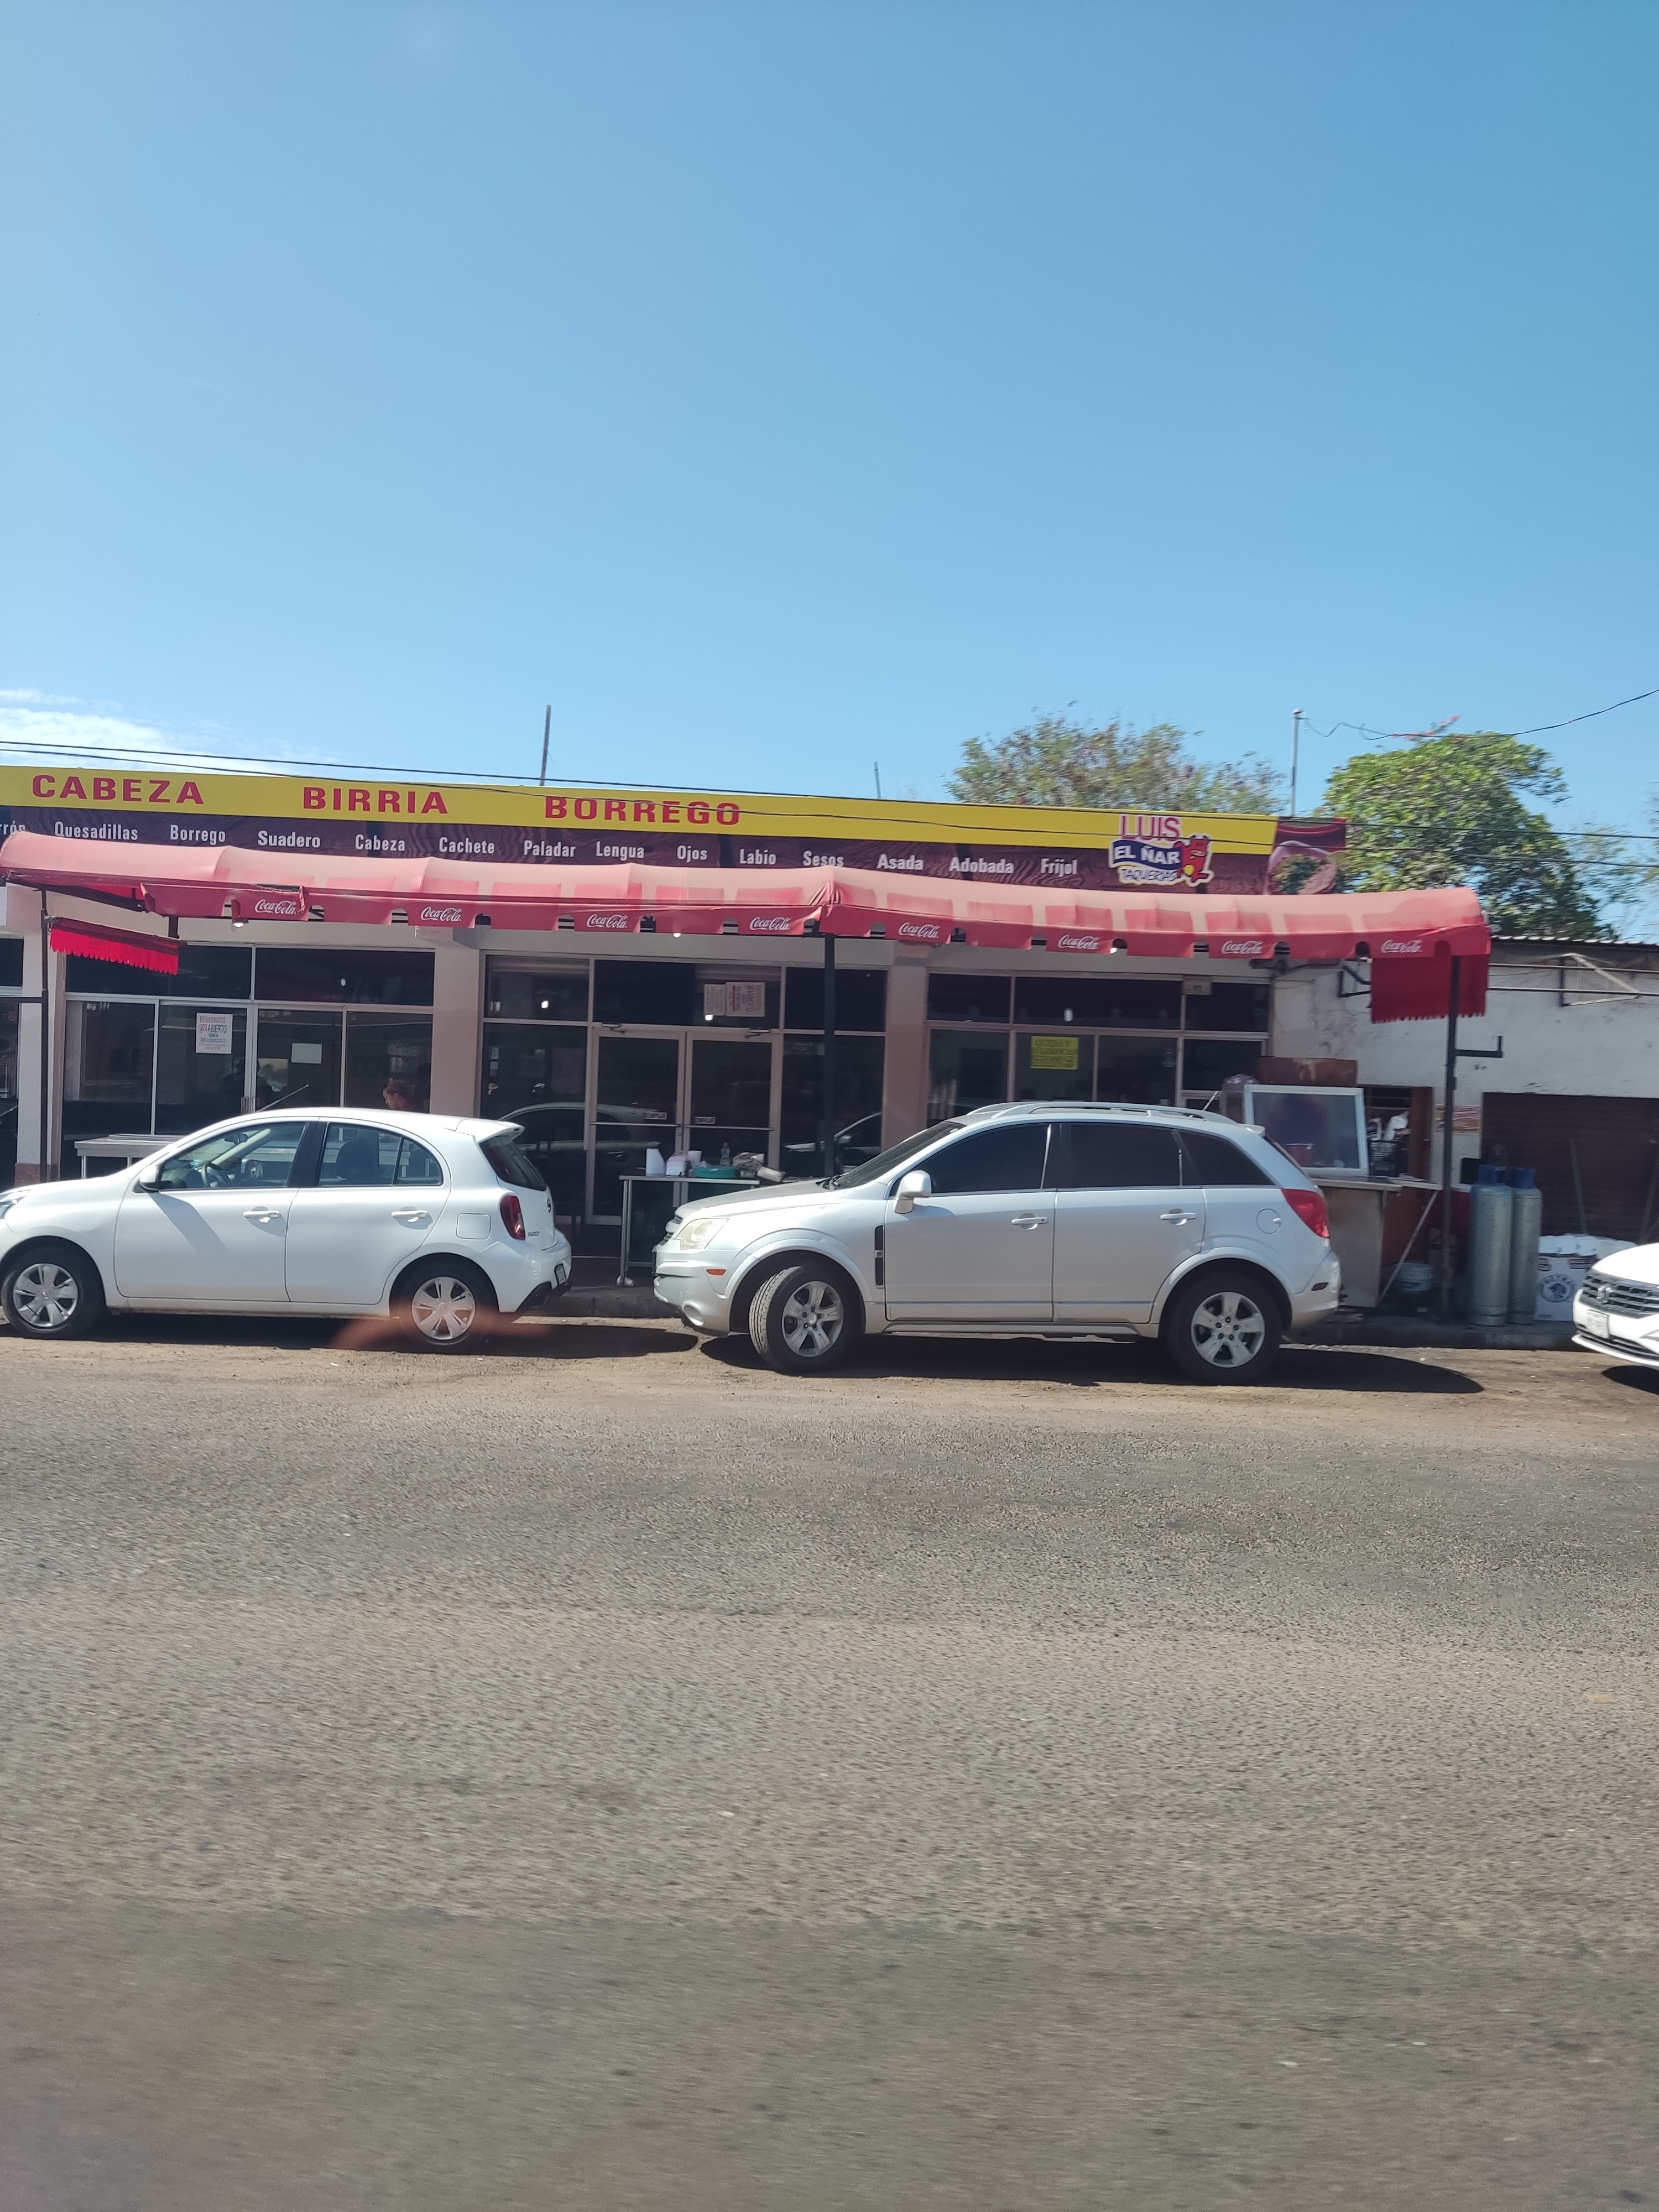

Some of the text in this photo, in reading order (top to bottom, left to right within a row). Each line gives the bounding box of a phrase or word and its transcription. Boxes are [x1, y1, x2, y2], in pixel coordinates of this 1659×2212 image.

[32, 774, 741, 826] CABEZA BIRRIA BORREGO
[1120, 815, 1181, 841] LUIS
[55, 821, 138, 840] Quesadillas
[170, 824, 226, 843] Borrego
[257, 830, 321, 849] Suadero
[354, 833, 406, 852] Cabeza
[439, 836, 495, 855] Cachete
[523, 839, 576, 858] Paladar
[596, 841, 645, 860] Lengua
[676, 844, 708, 862] Ojos
[739, 848, 776, 865] Labio
[802, 850, 844, 867] Sesos
[877, 853, 924, 871] Asada
[948, 856, 1015, 875] Adobada
[1040, 858, 1078, 878] Frijol
[1114, 845, 1181, 865] EL ÑAR
[255, 899, 296, 915] Coca-Cola
[420, 906, 462, 922] Coca-Cola
[586, 913, 629, 928] Coca-Cola
[749, 916, 791, 931] Coca-Cola
[899, 922, 940, 938] Coca-Cola
[207, 1024, 227, 1034] ABIERTO
